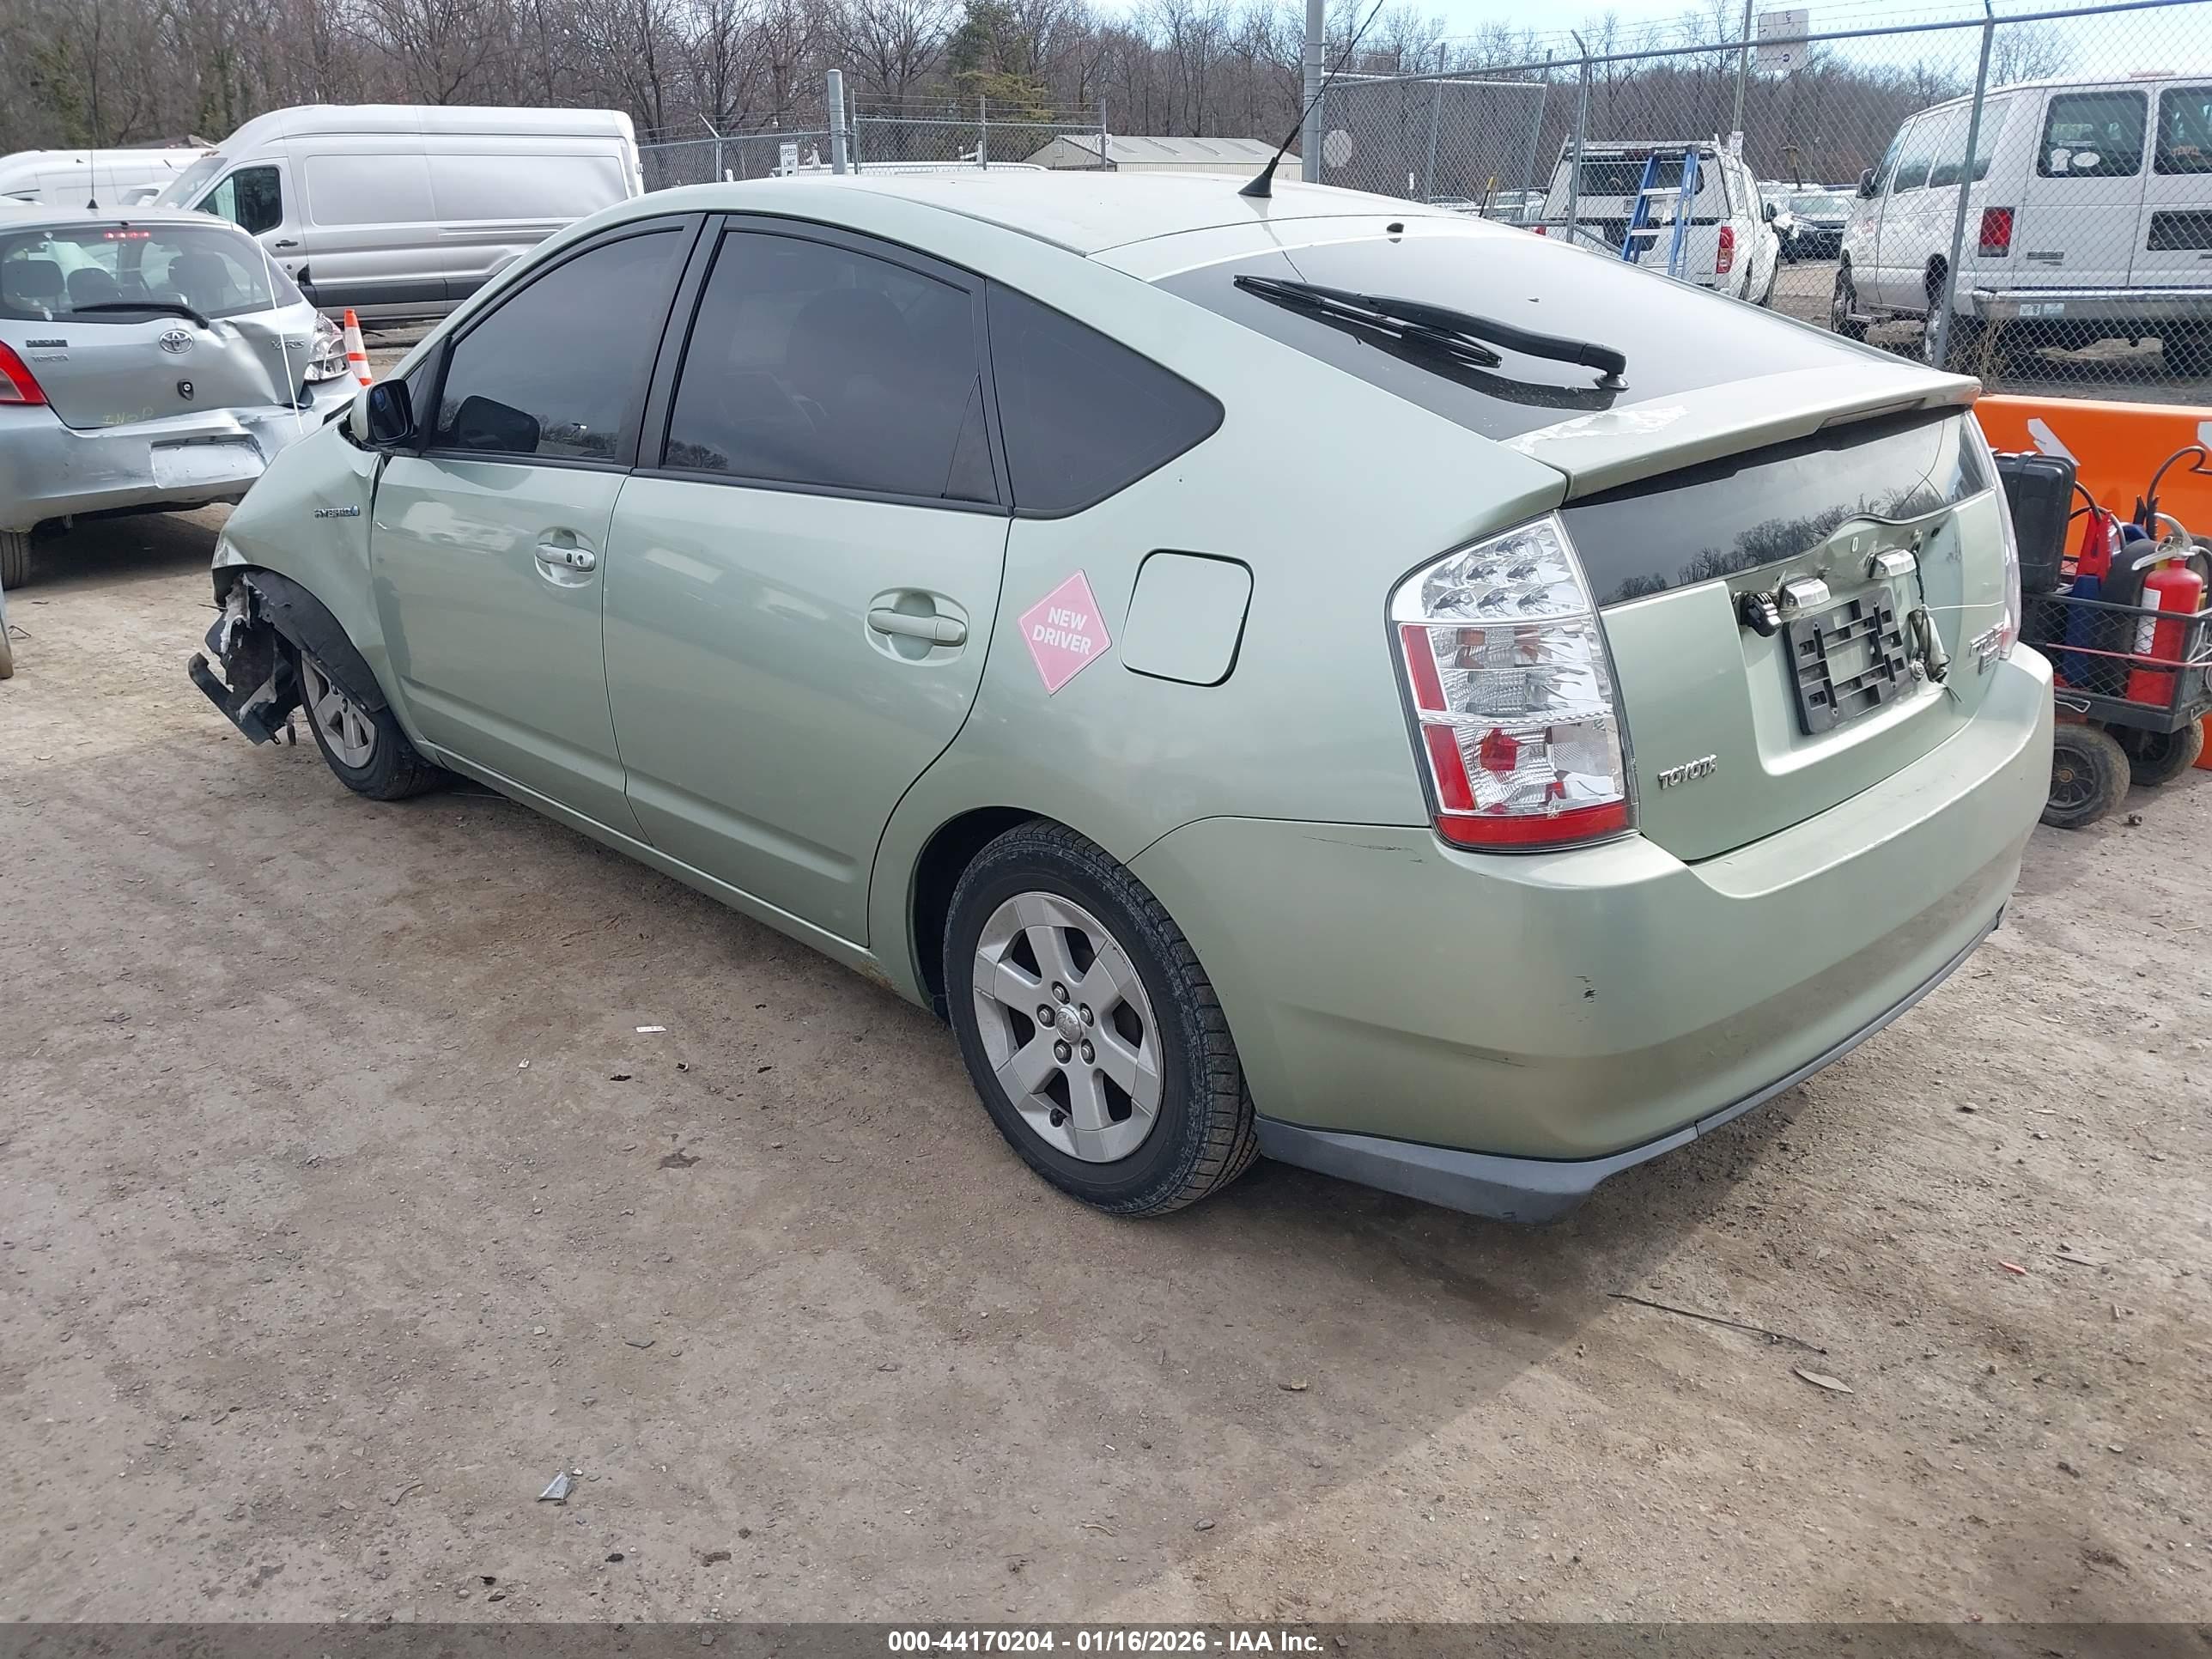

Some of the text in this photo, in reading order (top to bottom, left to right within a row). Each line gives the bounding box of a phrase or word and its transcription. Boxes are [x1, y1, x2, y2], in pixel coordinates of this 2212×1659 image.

[781, 148, 797, 156] SPEED
[783, 159, 796, 167] LIMIT
[1047, 606, 1088, 632] NEW
[1031, 624, 1093, 655] DRIVER
[1657, 753, 1718, 791] TOYOTA
